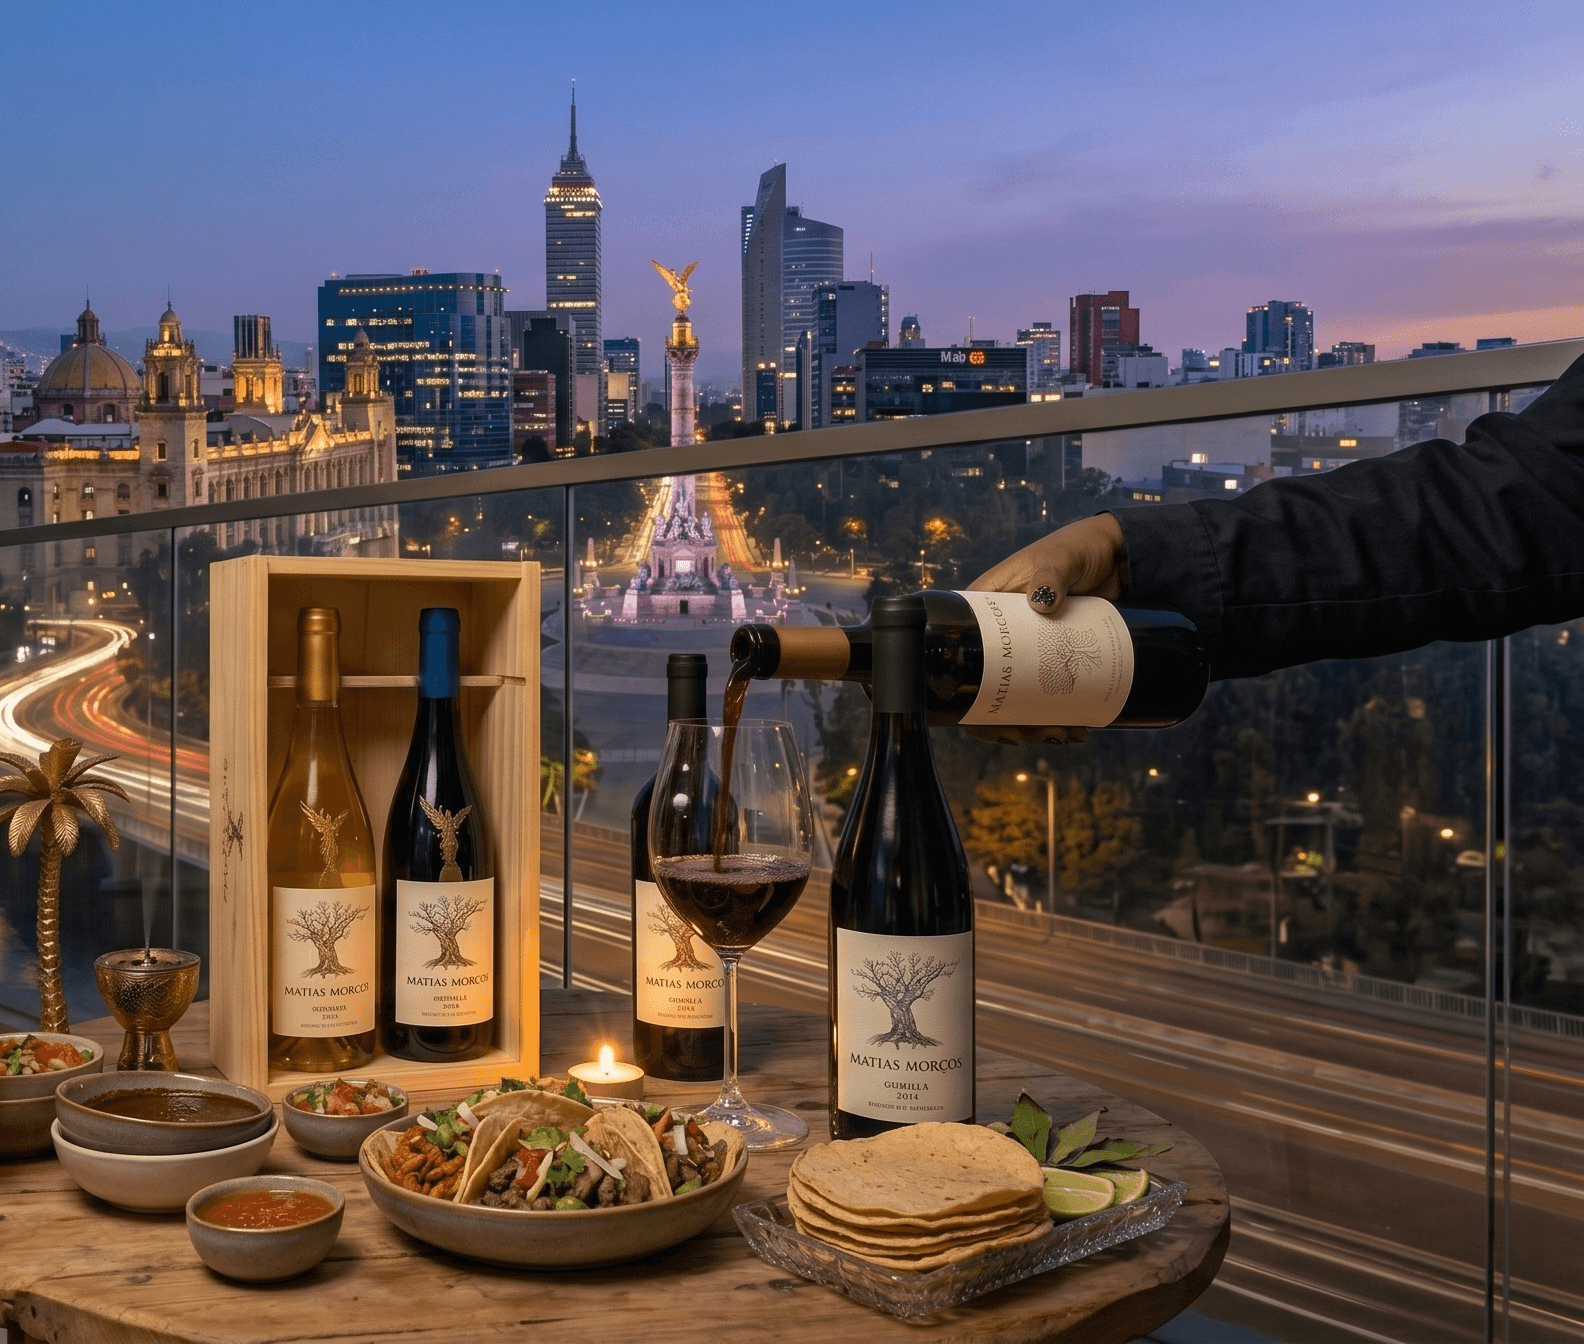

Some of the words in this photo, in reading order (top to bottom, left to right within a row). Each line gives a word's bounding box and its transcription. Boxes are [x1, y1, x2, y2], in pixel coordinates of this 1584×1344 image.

[987, 666, 1012, 714] MATIAS
[407, 976, 447, 987] MATIAS
[646, 976, 681, 988] MATIAS
[284, 986, 326, 997] MATIAS
[850, 1052, 900, 1071] MATIAS
[884, 1081, 929, 1091] GUMILLA
[896, 1092, 919, 1100] 2014
